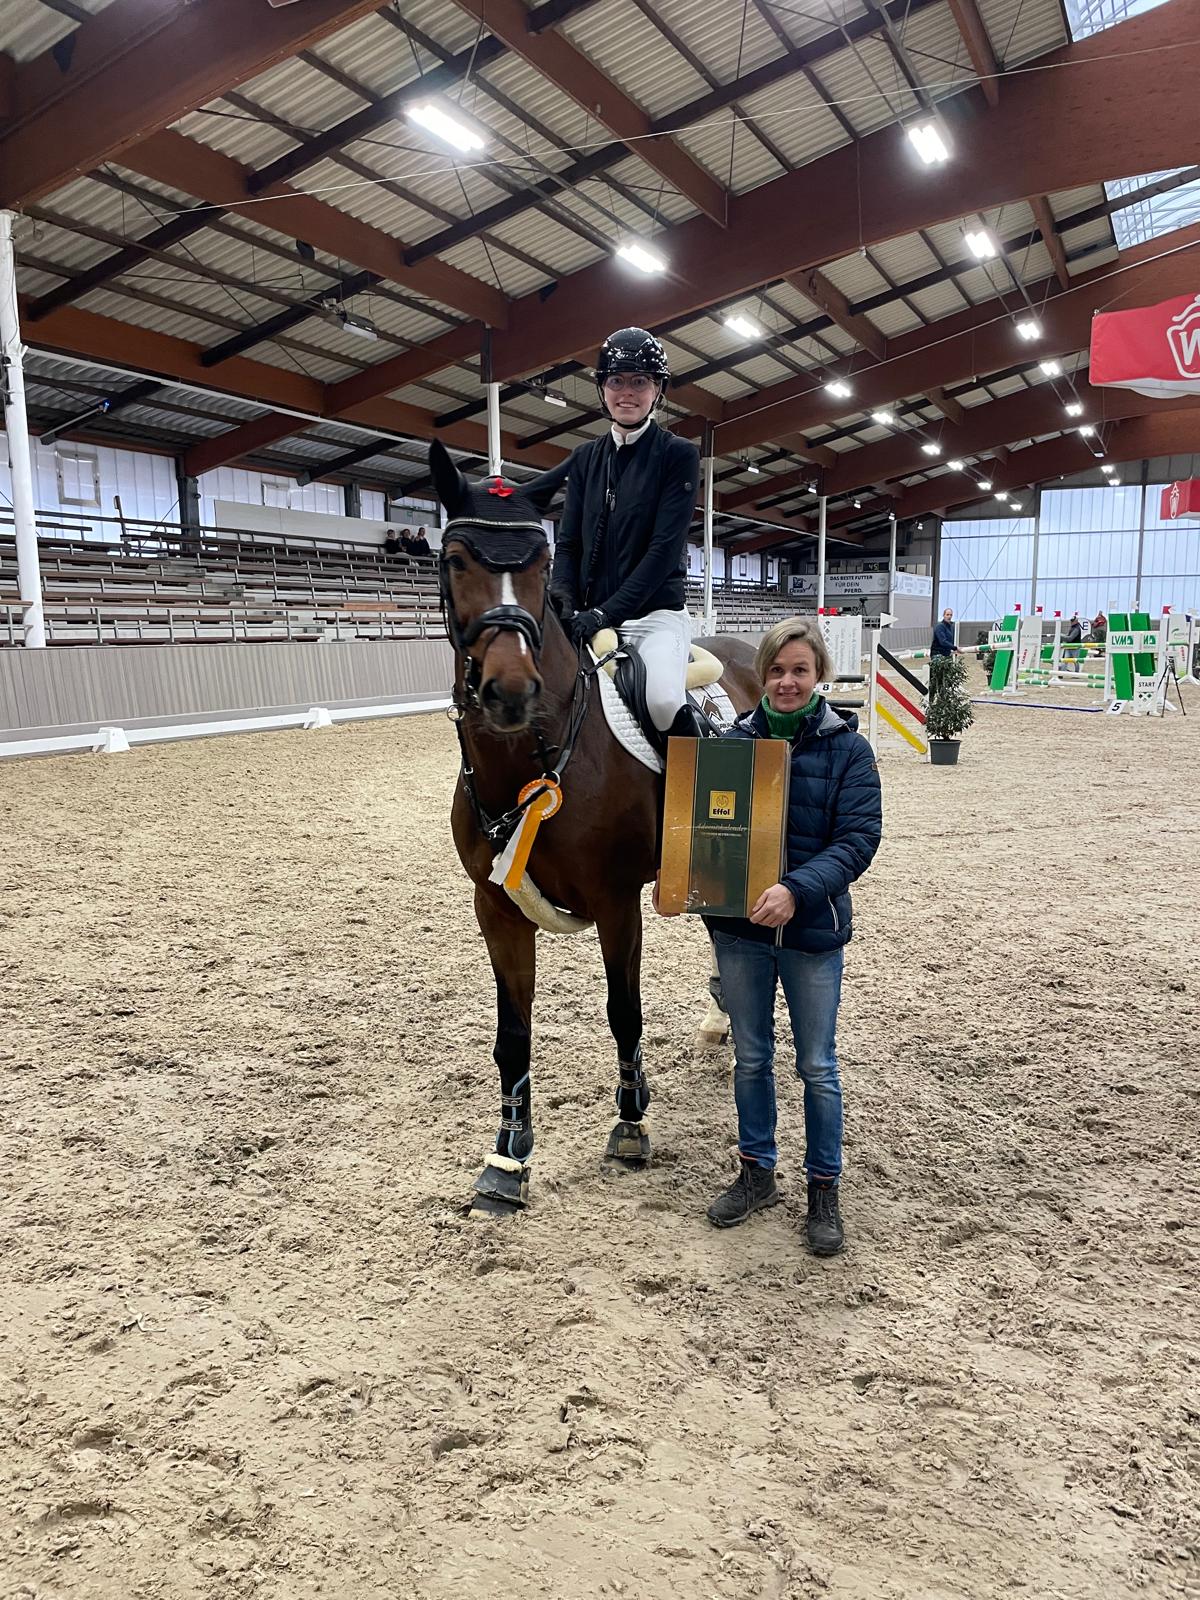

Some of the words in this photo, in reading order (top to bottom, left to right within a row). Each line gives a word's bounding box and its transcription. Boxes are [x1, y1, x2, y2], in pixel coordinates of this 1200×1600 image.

[1111, 635, 1127, 645] LVM
[1111, 702, 1122, 712] 5
[712, 808, 731, 816] Effol
